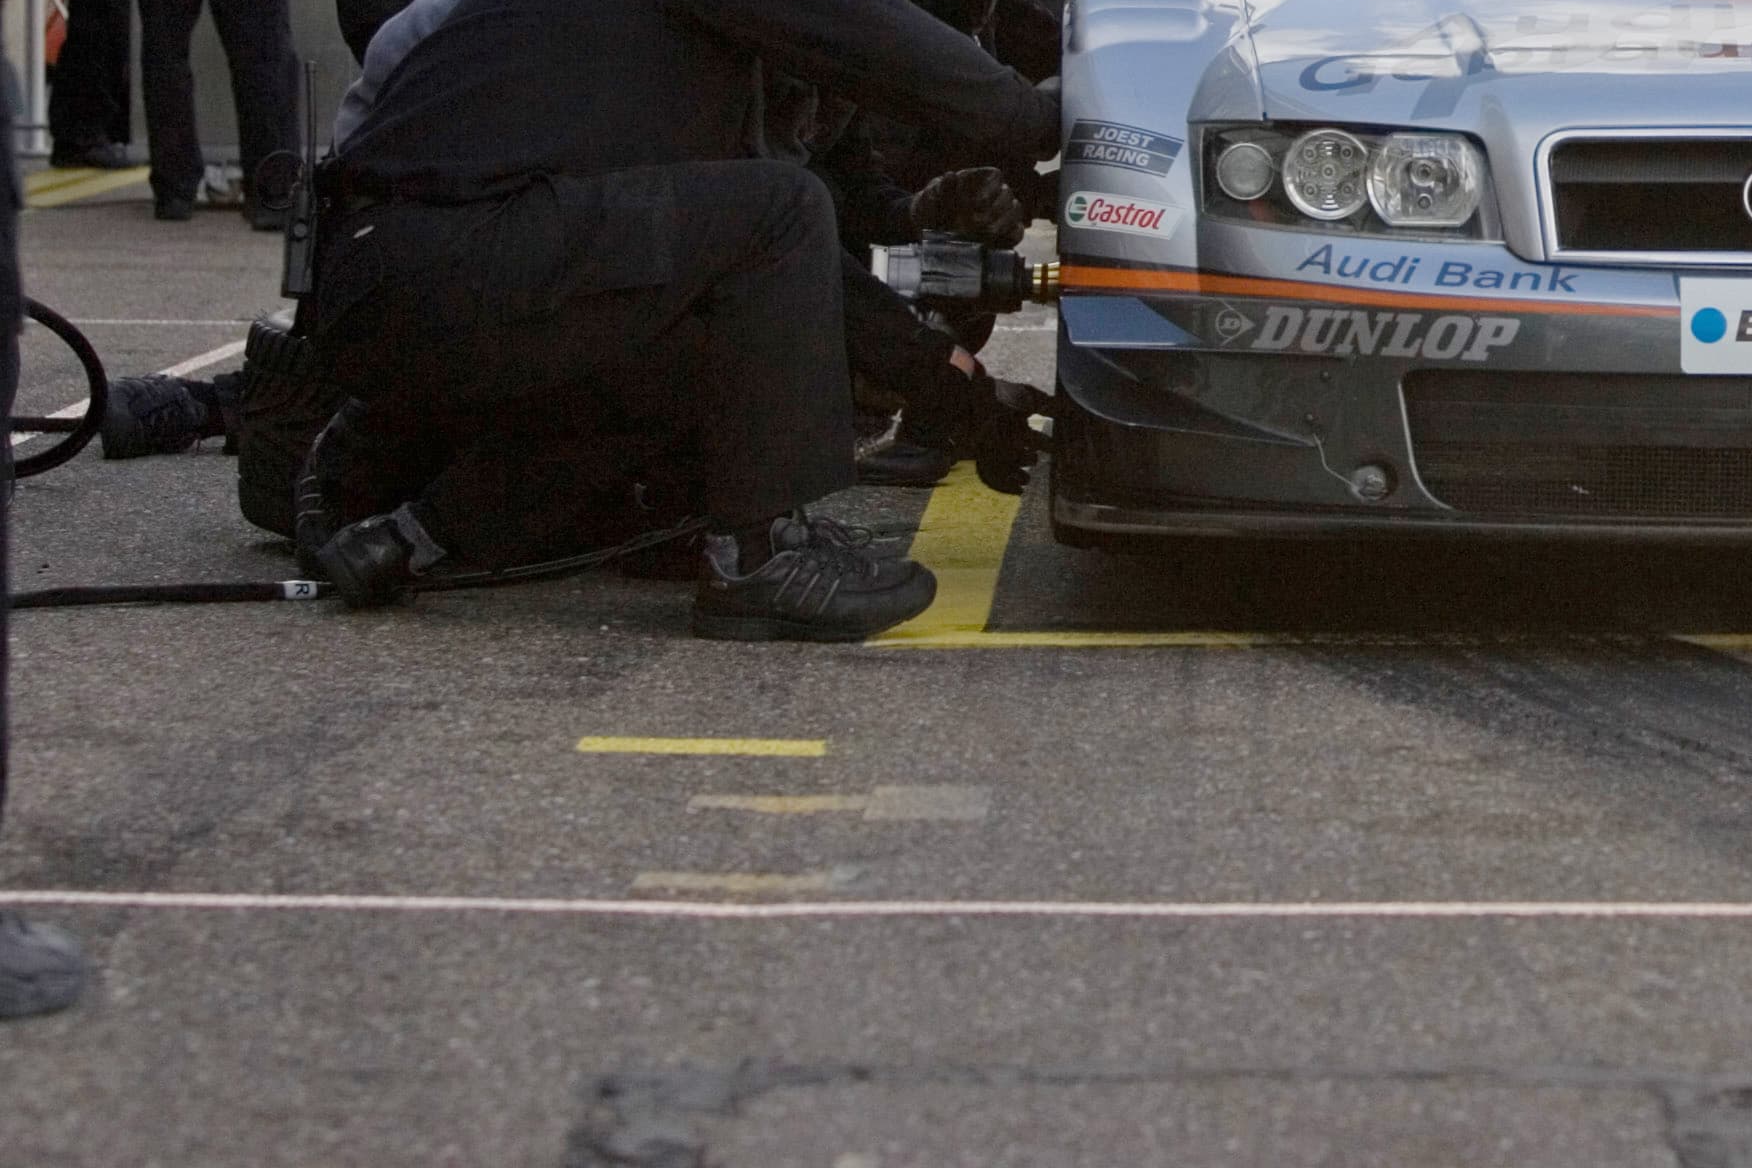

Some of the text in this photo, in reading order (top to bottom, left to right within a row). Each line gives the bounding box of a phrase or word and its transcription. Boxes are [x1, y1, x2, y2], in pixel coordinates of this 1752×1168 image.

[1093, 126, 1154, 148] JOEST
[1082, 144, 1150, 167] RACING
[1087, 198, 1166, 230] Castrol
[1296, 243, 1577, 294] Audi Bank
[1250, 305, 1521, 362] DUNLOP
[295, 583, 310, 597] R
